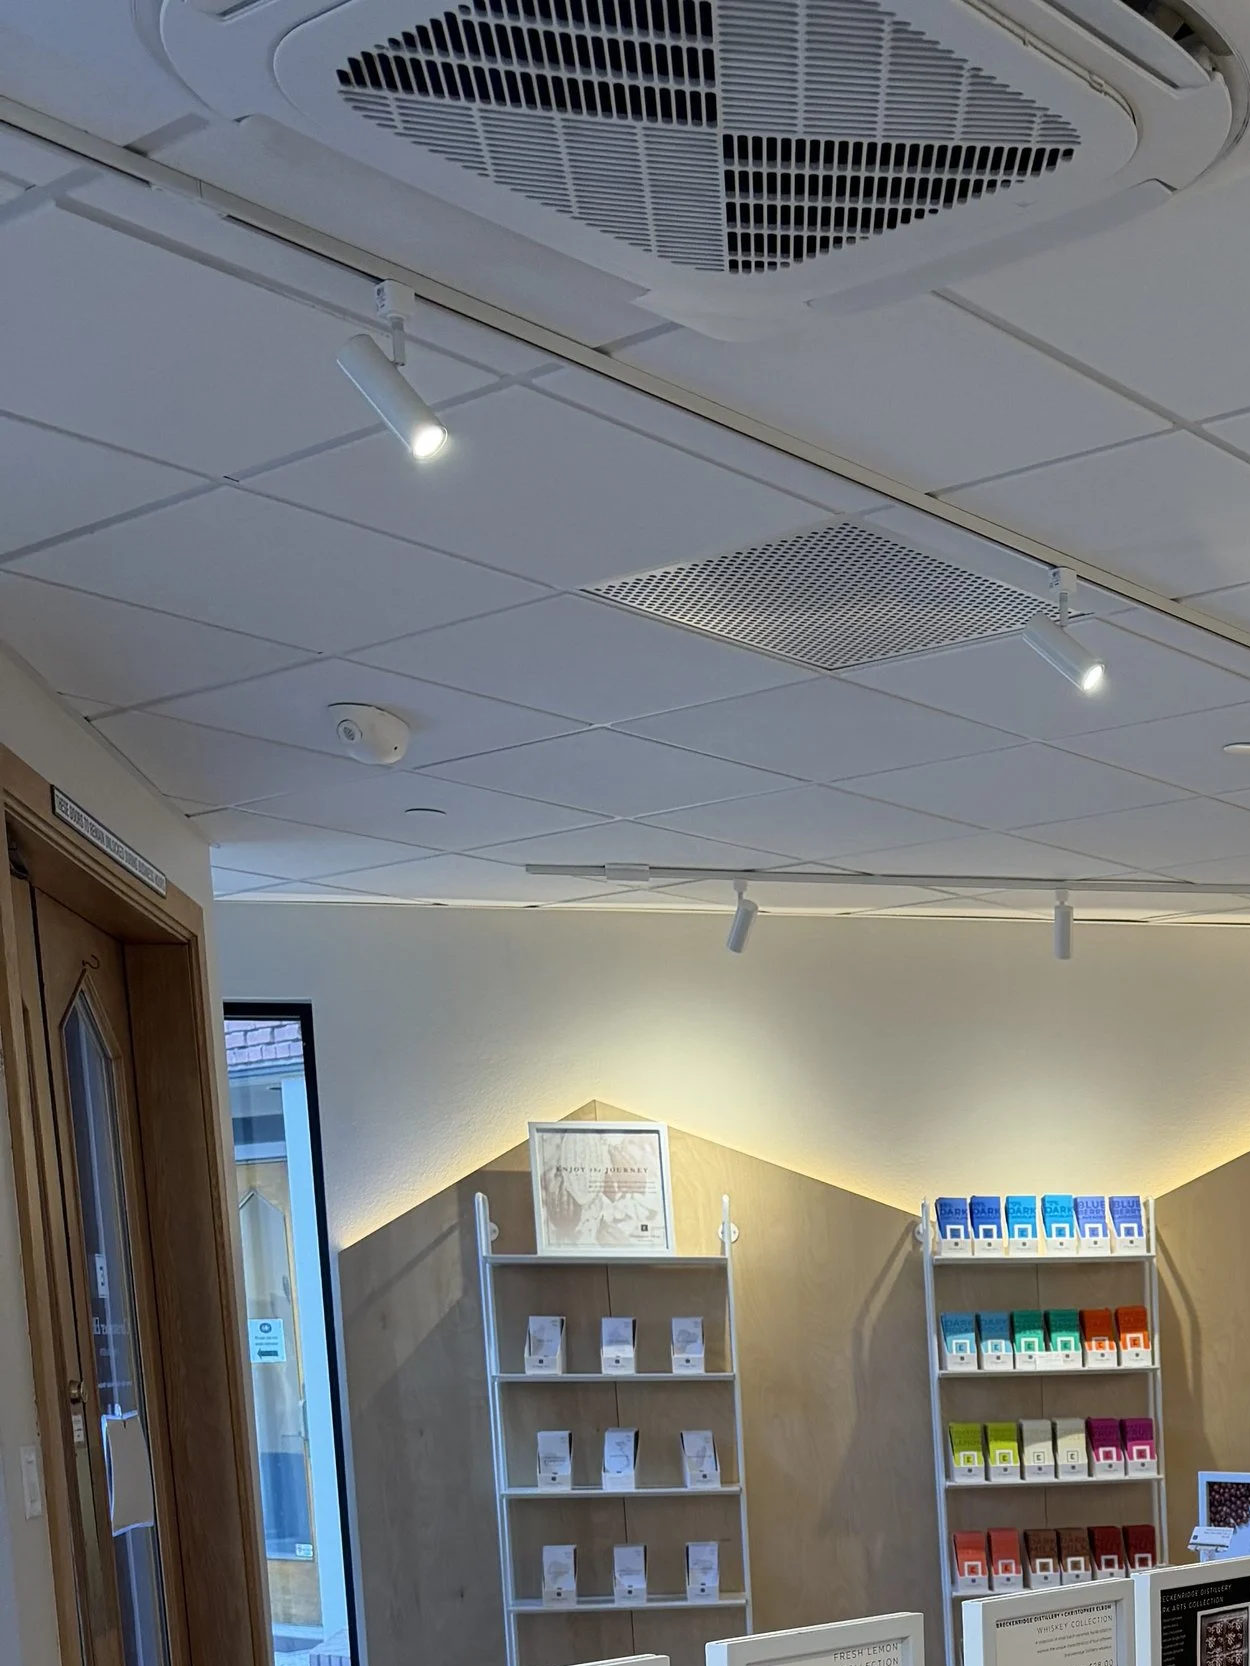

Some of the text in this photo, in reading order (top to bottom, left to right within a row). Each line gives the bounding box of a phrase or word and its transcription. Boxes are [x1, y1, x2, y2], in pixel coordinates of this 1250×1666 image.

[556, 1165, 586, 1174] ENJOY
[604, 1165, 649, 1174] JOURNEY
[1080, 1200, 1105, 1209] BLUE
[1114, 1199, 1141, 1209] BLUE
[940, 1208, 968, 1216] DARK
[973, 1207, 1000, 1215] DARK
[1008, 1206, 1036, 1215] DARK
[1199, 1583, 1232, 1596] DISTILLERY
[1171, 1603, 1187, 1611] ARTS
[1188, 1596, 1224, 1609] COLLECTION
[996, 1603, 1112, 1629] BRECKENRIDGE DISTILLERY CHRISTOPHER ELBOW
[1036, 1614, 1113, 1634] WHISKEY COLLECTION
[833, 1642, 899, 1661] FRESH LEMON
